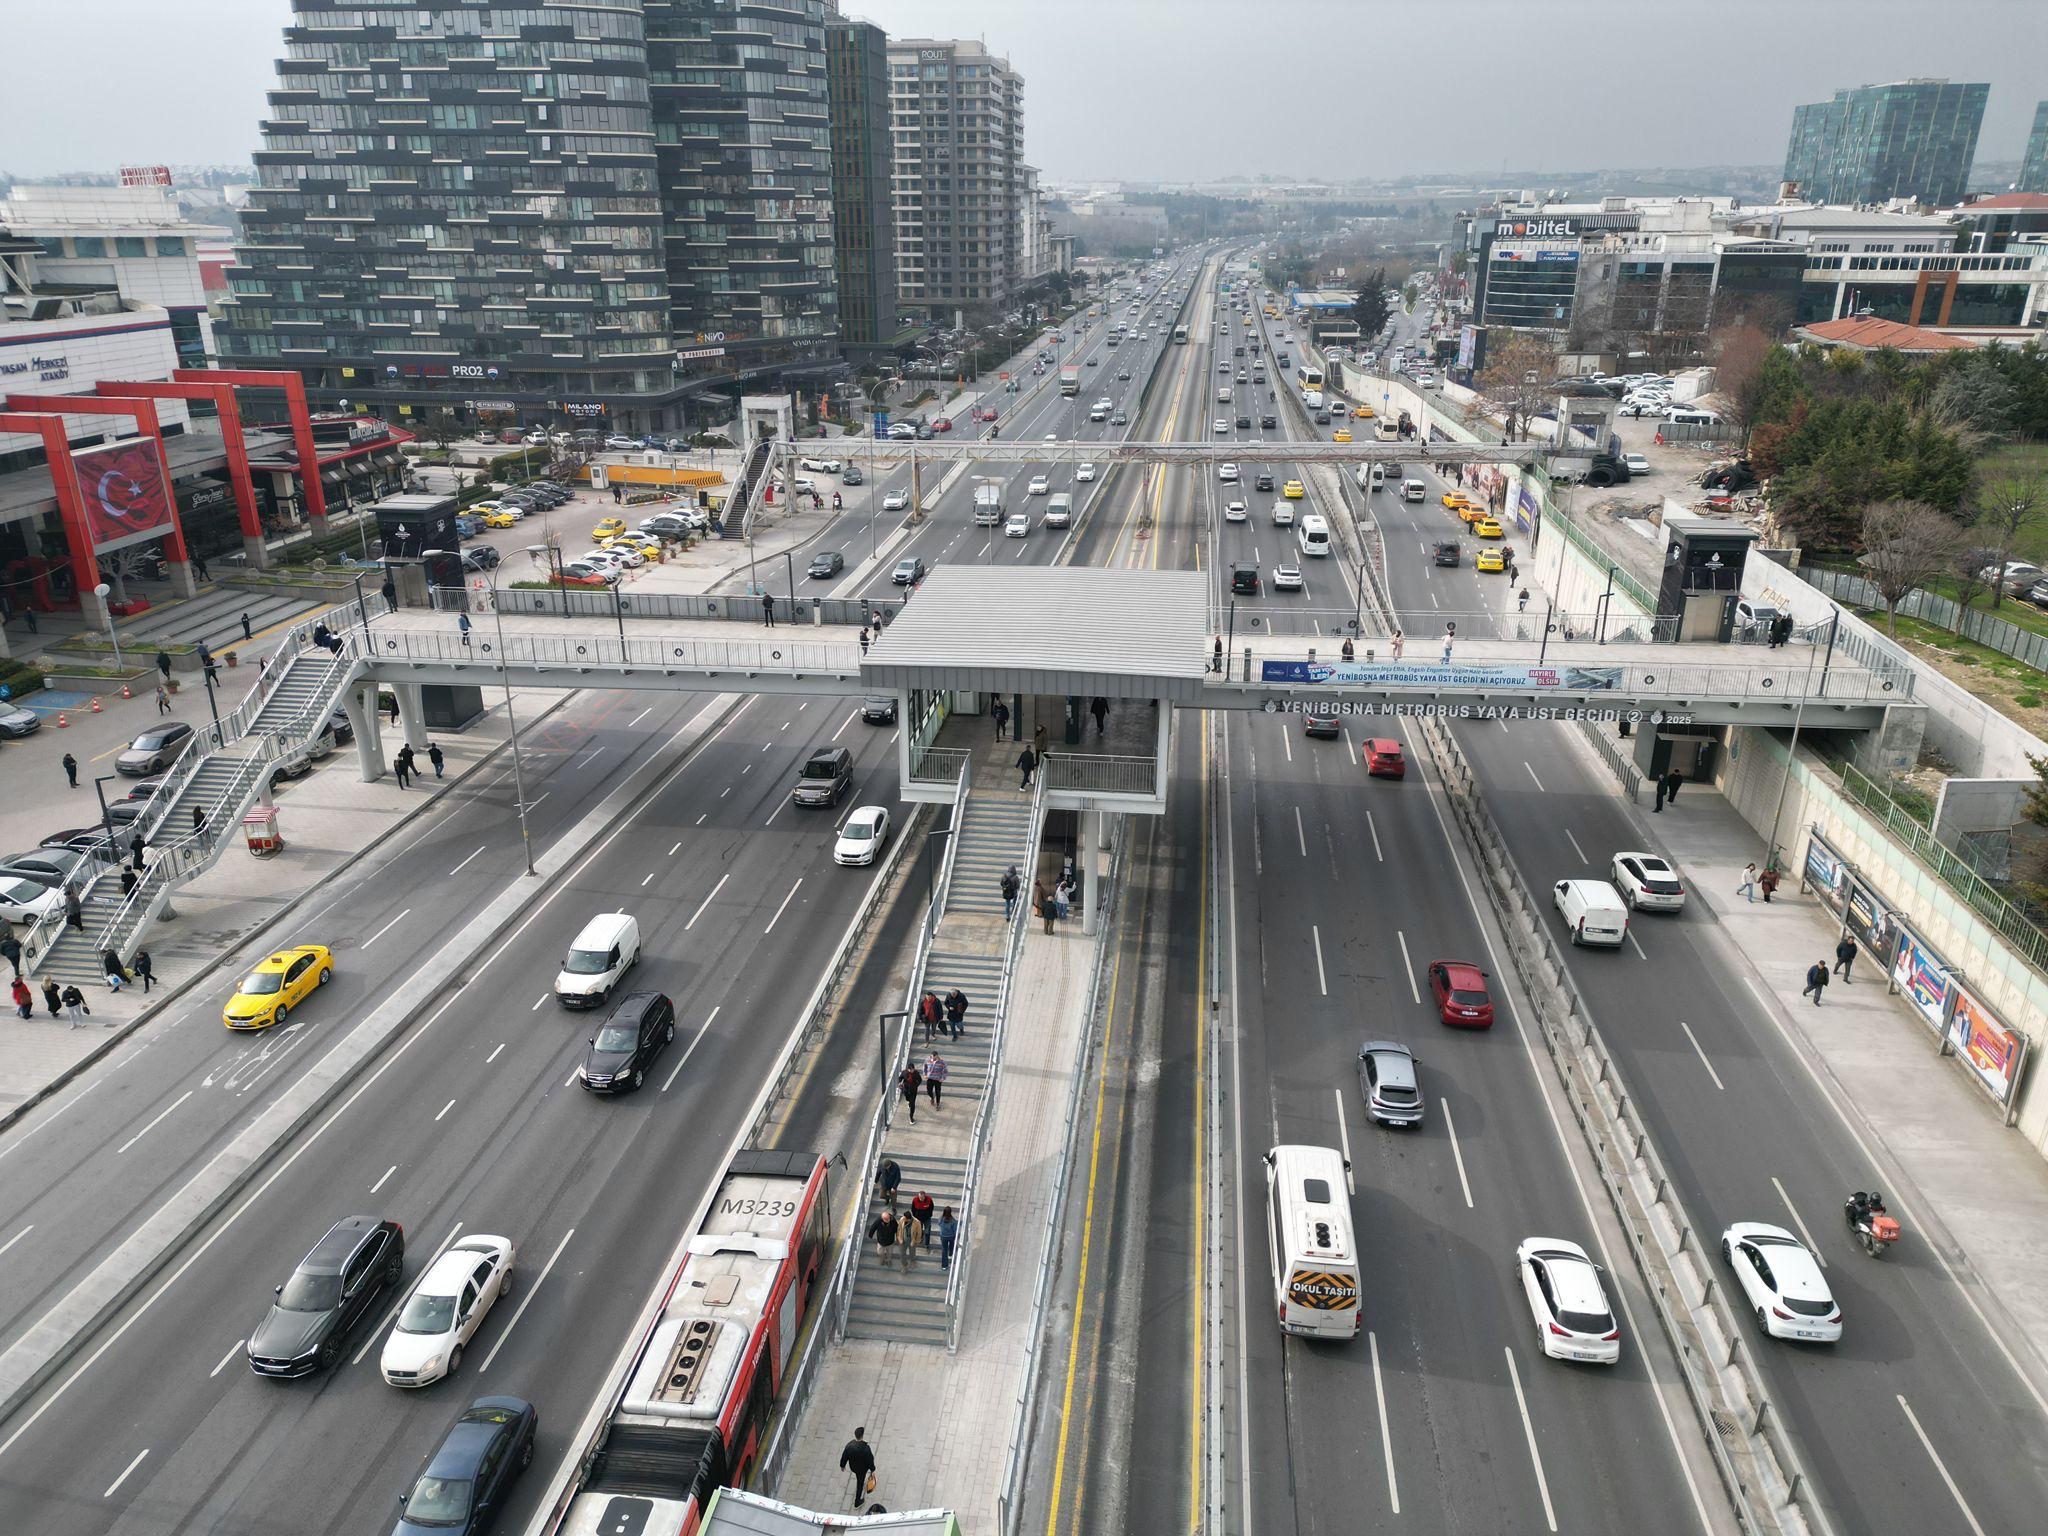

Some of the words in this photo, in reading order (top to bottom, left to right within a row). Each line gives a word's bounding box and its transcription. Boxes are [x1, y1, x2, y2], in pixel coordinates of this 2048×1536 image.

[40, 368, 69, 382] ATAKÖY
[452, 365, 484, 376] PRO2
[1379, 673, 1418, 682] METROBÜS
[1438, 674, 1452, 682] ÜST
[1489, 677, 1526, 686] AÇIYORUZ
[1477, 705, 1520, 720] YAYA
[1666, 715, 1692, 724] 2025
[720, 1198, 796, 1218] M3239
[1293, 1282, 1322, 1294] OKUL
[1323, 1286, 1356, 1297] TAŞITI
